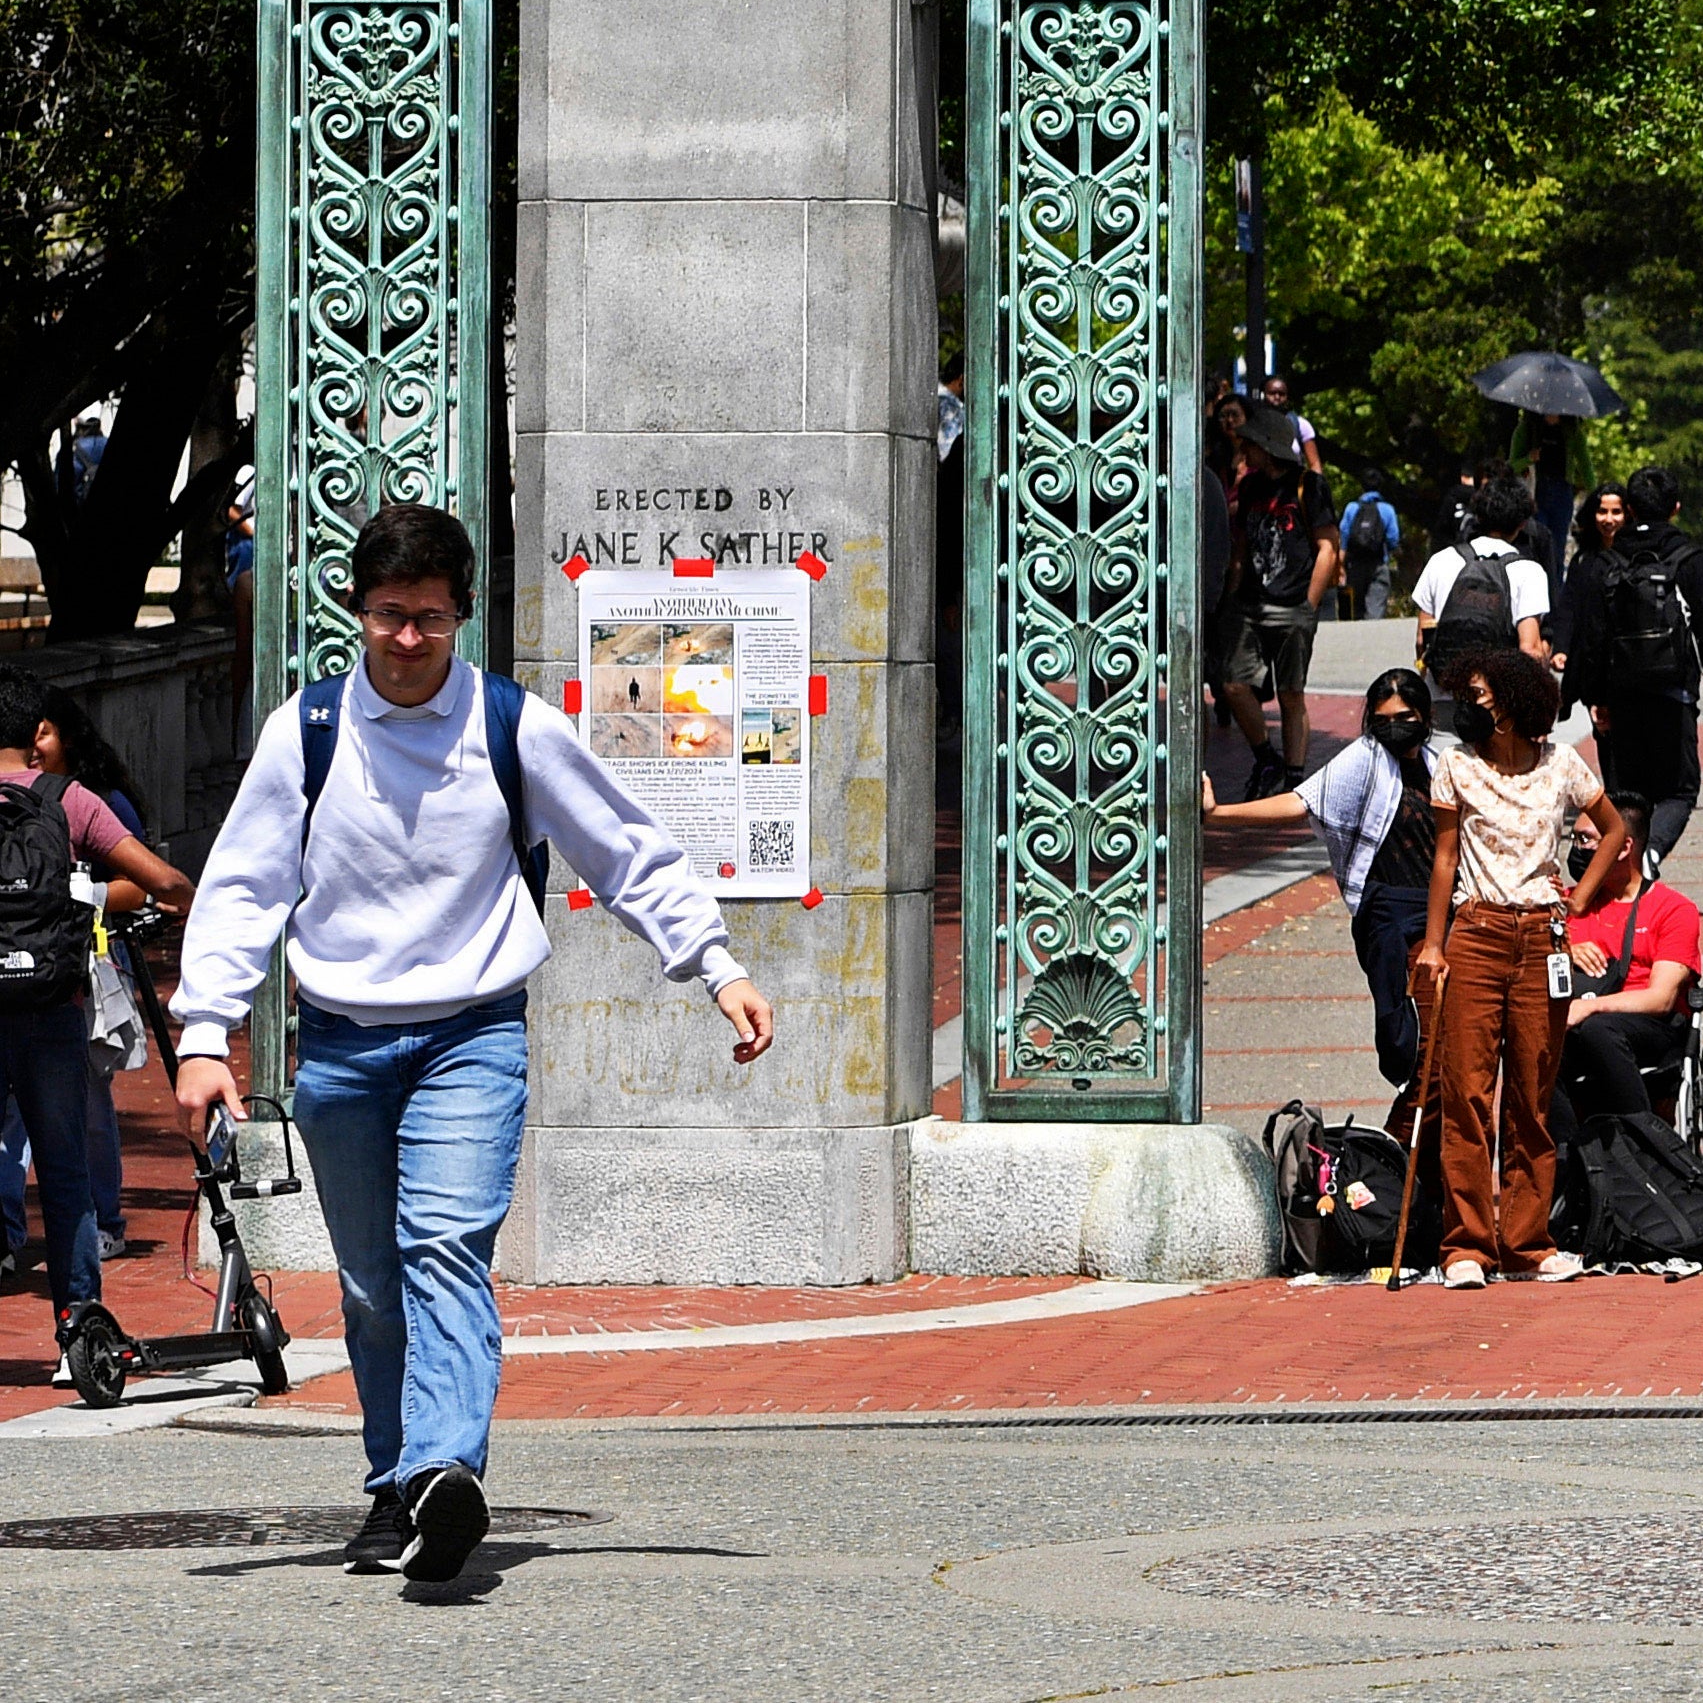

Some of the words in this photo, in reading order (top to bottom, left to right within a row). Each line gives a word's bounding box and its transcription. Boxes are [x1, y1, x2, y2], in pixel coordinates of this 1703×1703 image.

[595, 487, 734, 512] ERECTED
[758, 487, 796, 511] BY
[551, 531, 642, 565] JANE
[658, 531, 681, 565] K
[699, 531, 834, 565] SATHER
